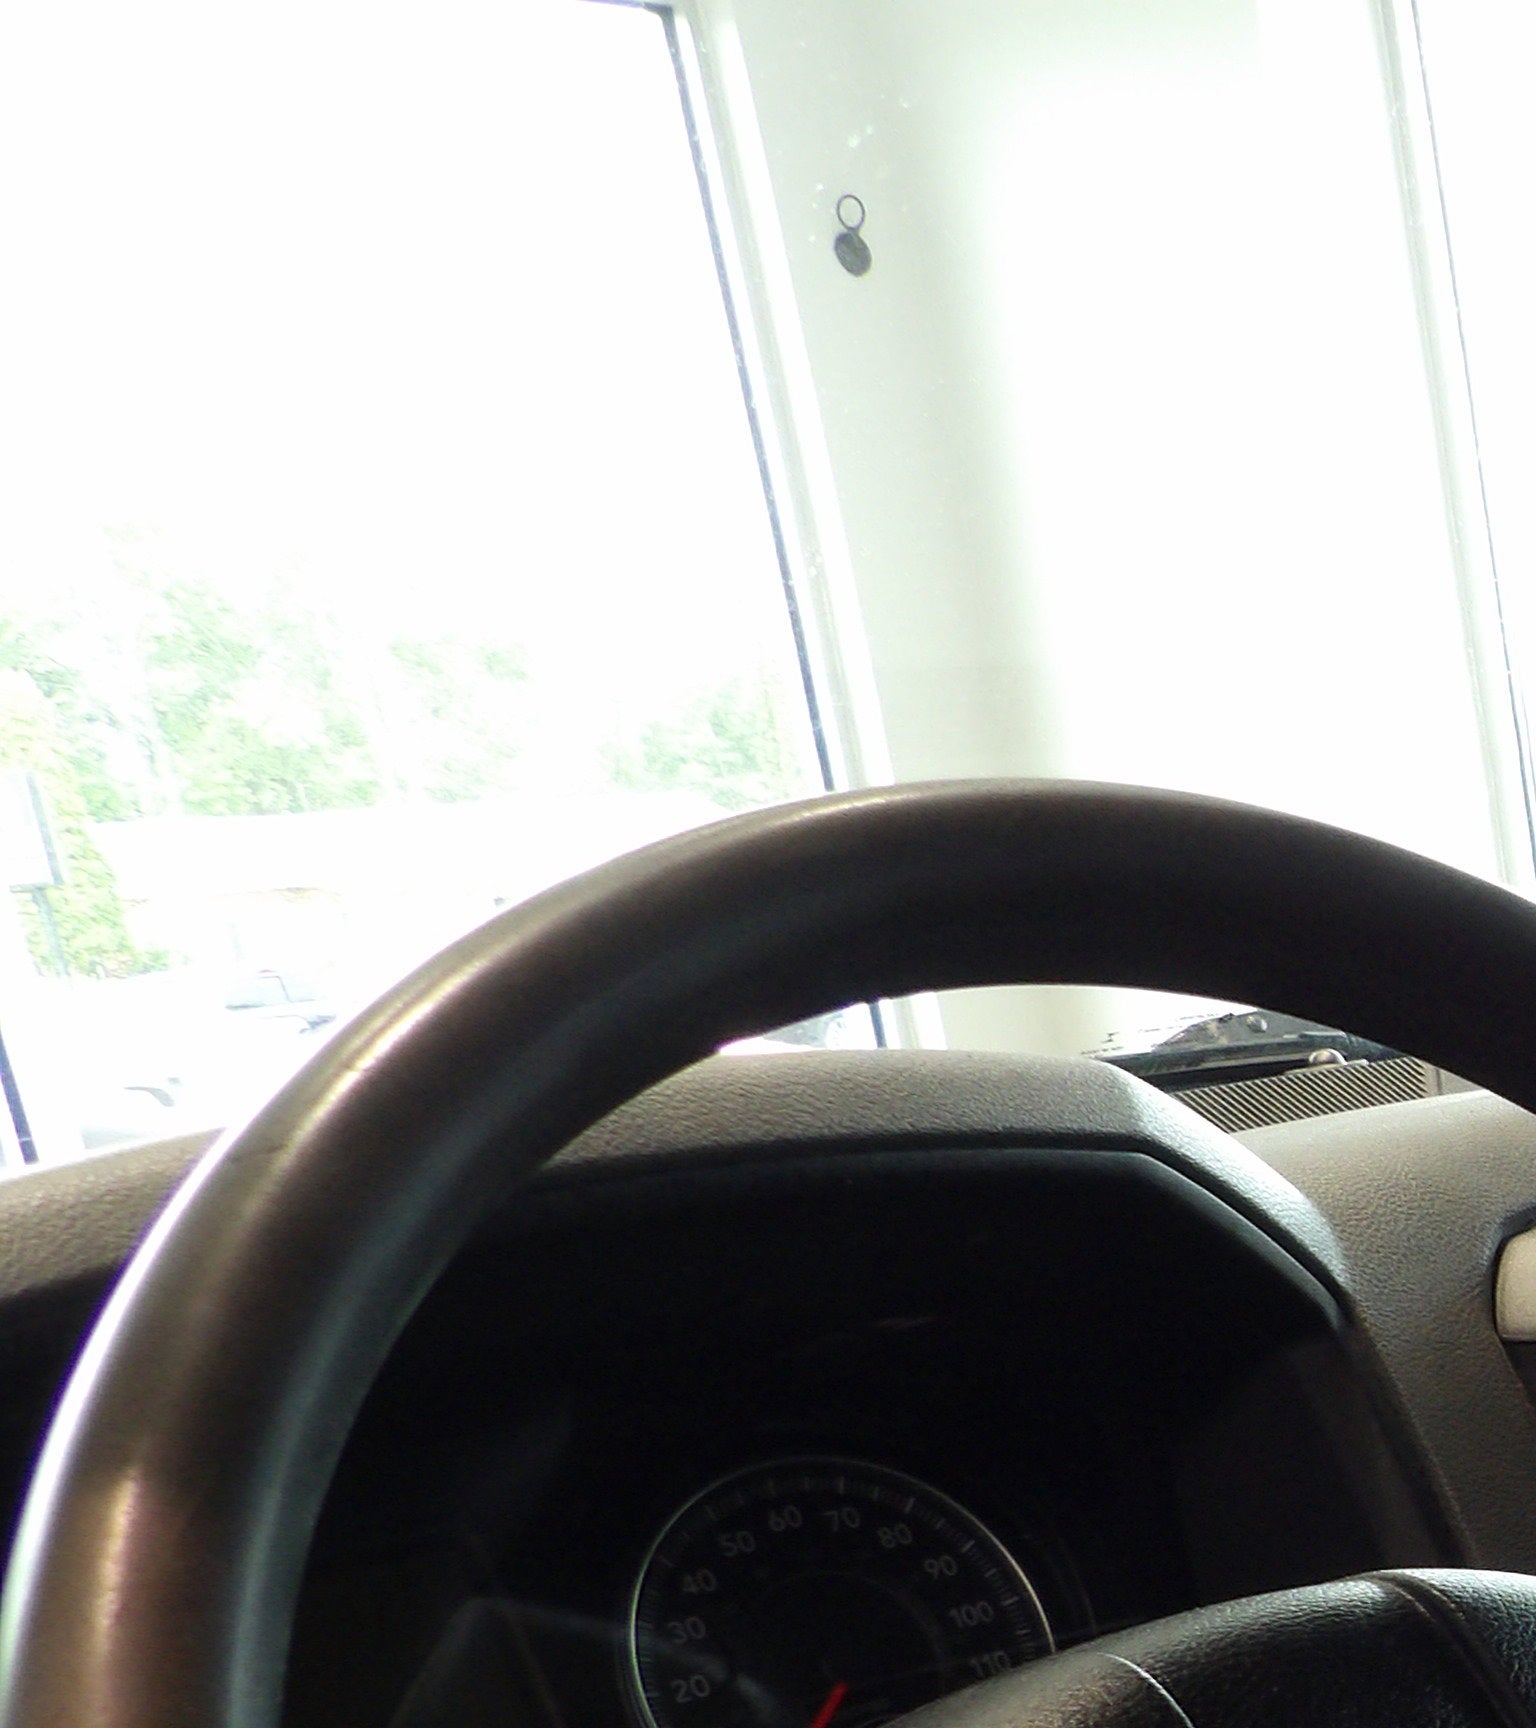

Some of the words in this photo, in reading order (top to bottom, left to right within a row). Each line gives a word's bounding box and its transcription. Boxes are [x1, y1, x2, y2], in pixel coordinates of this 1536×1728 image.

[768, 1505, 802, 1531] 60
[823, 1507, 861, 1532] 70
[719, 1530, 756, 1556] 50
[877, 1523, 912, 1549] 80
[923, 1554, 958, 1581] 90
[682, 1568, 718, 1594] 40
[949, 1601, 994, 1628] 100
[667, 1616, 706, 1643] 30
[671, 1675, 710, 1703] 20
